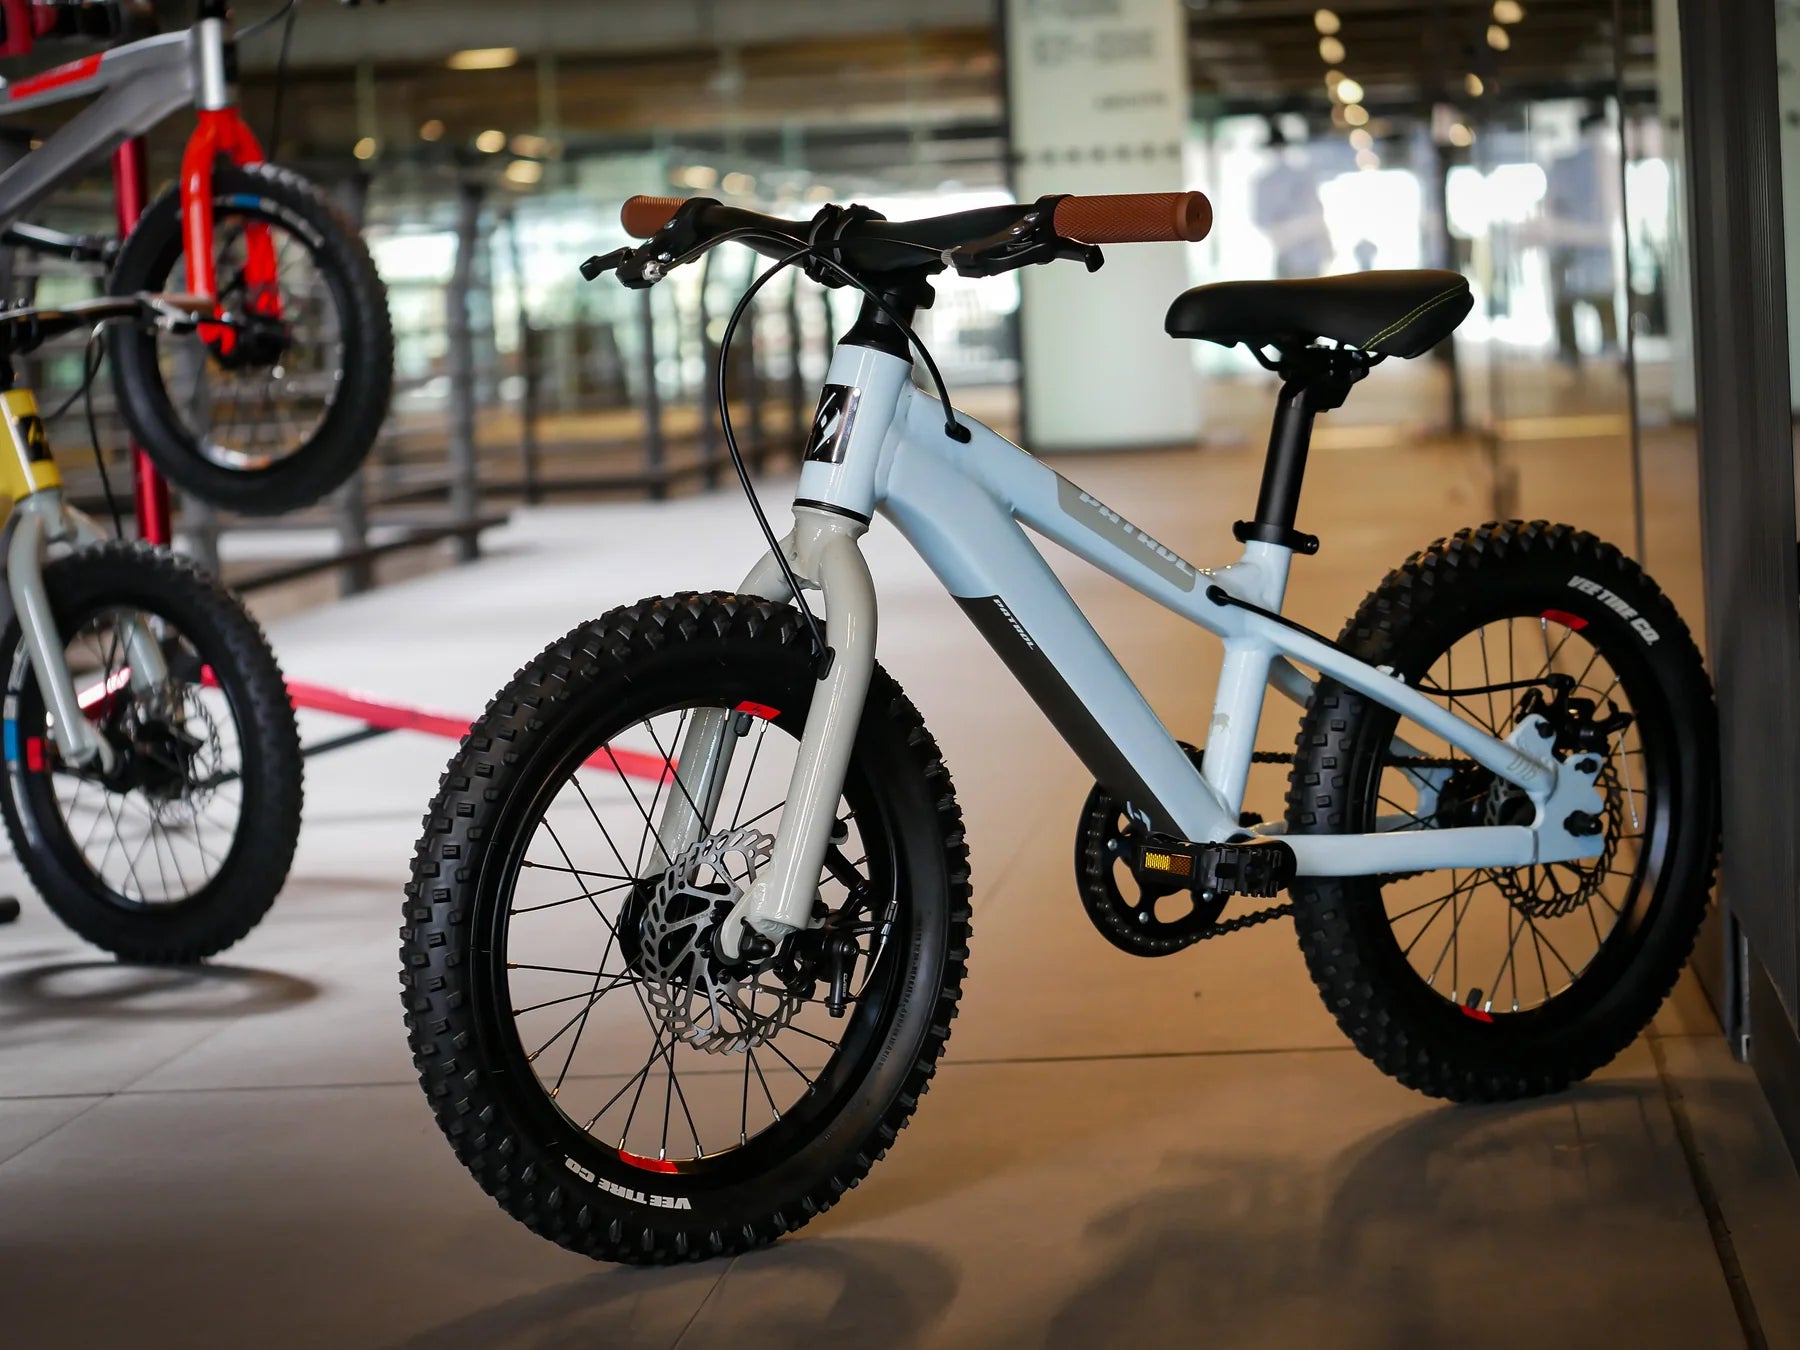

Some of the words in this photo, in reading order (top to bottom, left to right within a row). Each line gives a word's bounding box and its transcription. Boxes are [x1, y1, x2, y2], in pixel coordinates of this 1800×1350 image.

[1567, 575, 1603, 596] VEE
[1597, 589, 1639, 621] TIRE
[993, 599, 1035, 651] PATROL
[597, 1177, 648, 1205] TIRE
[649, 1194, 692, 1210] VEE
